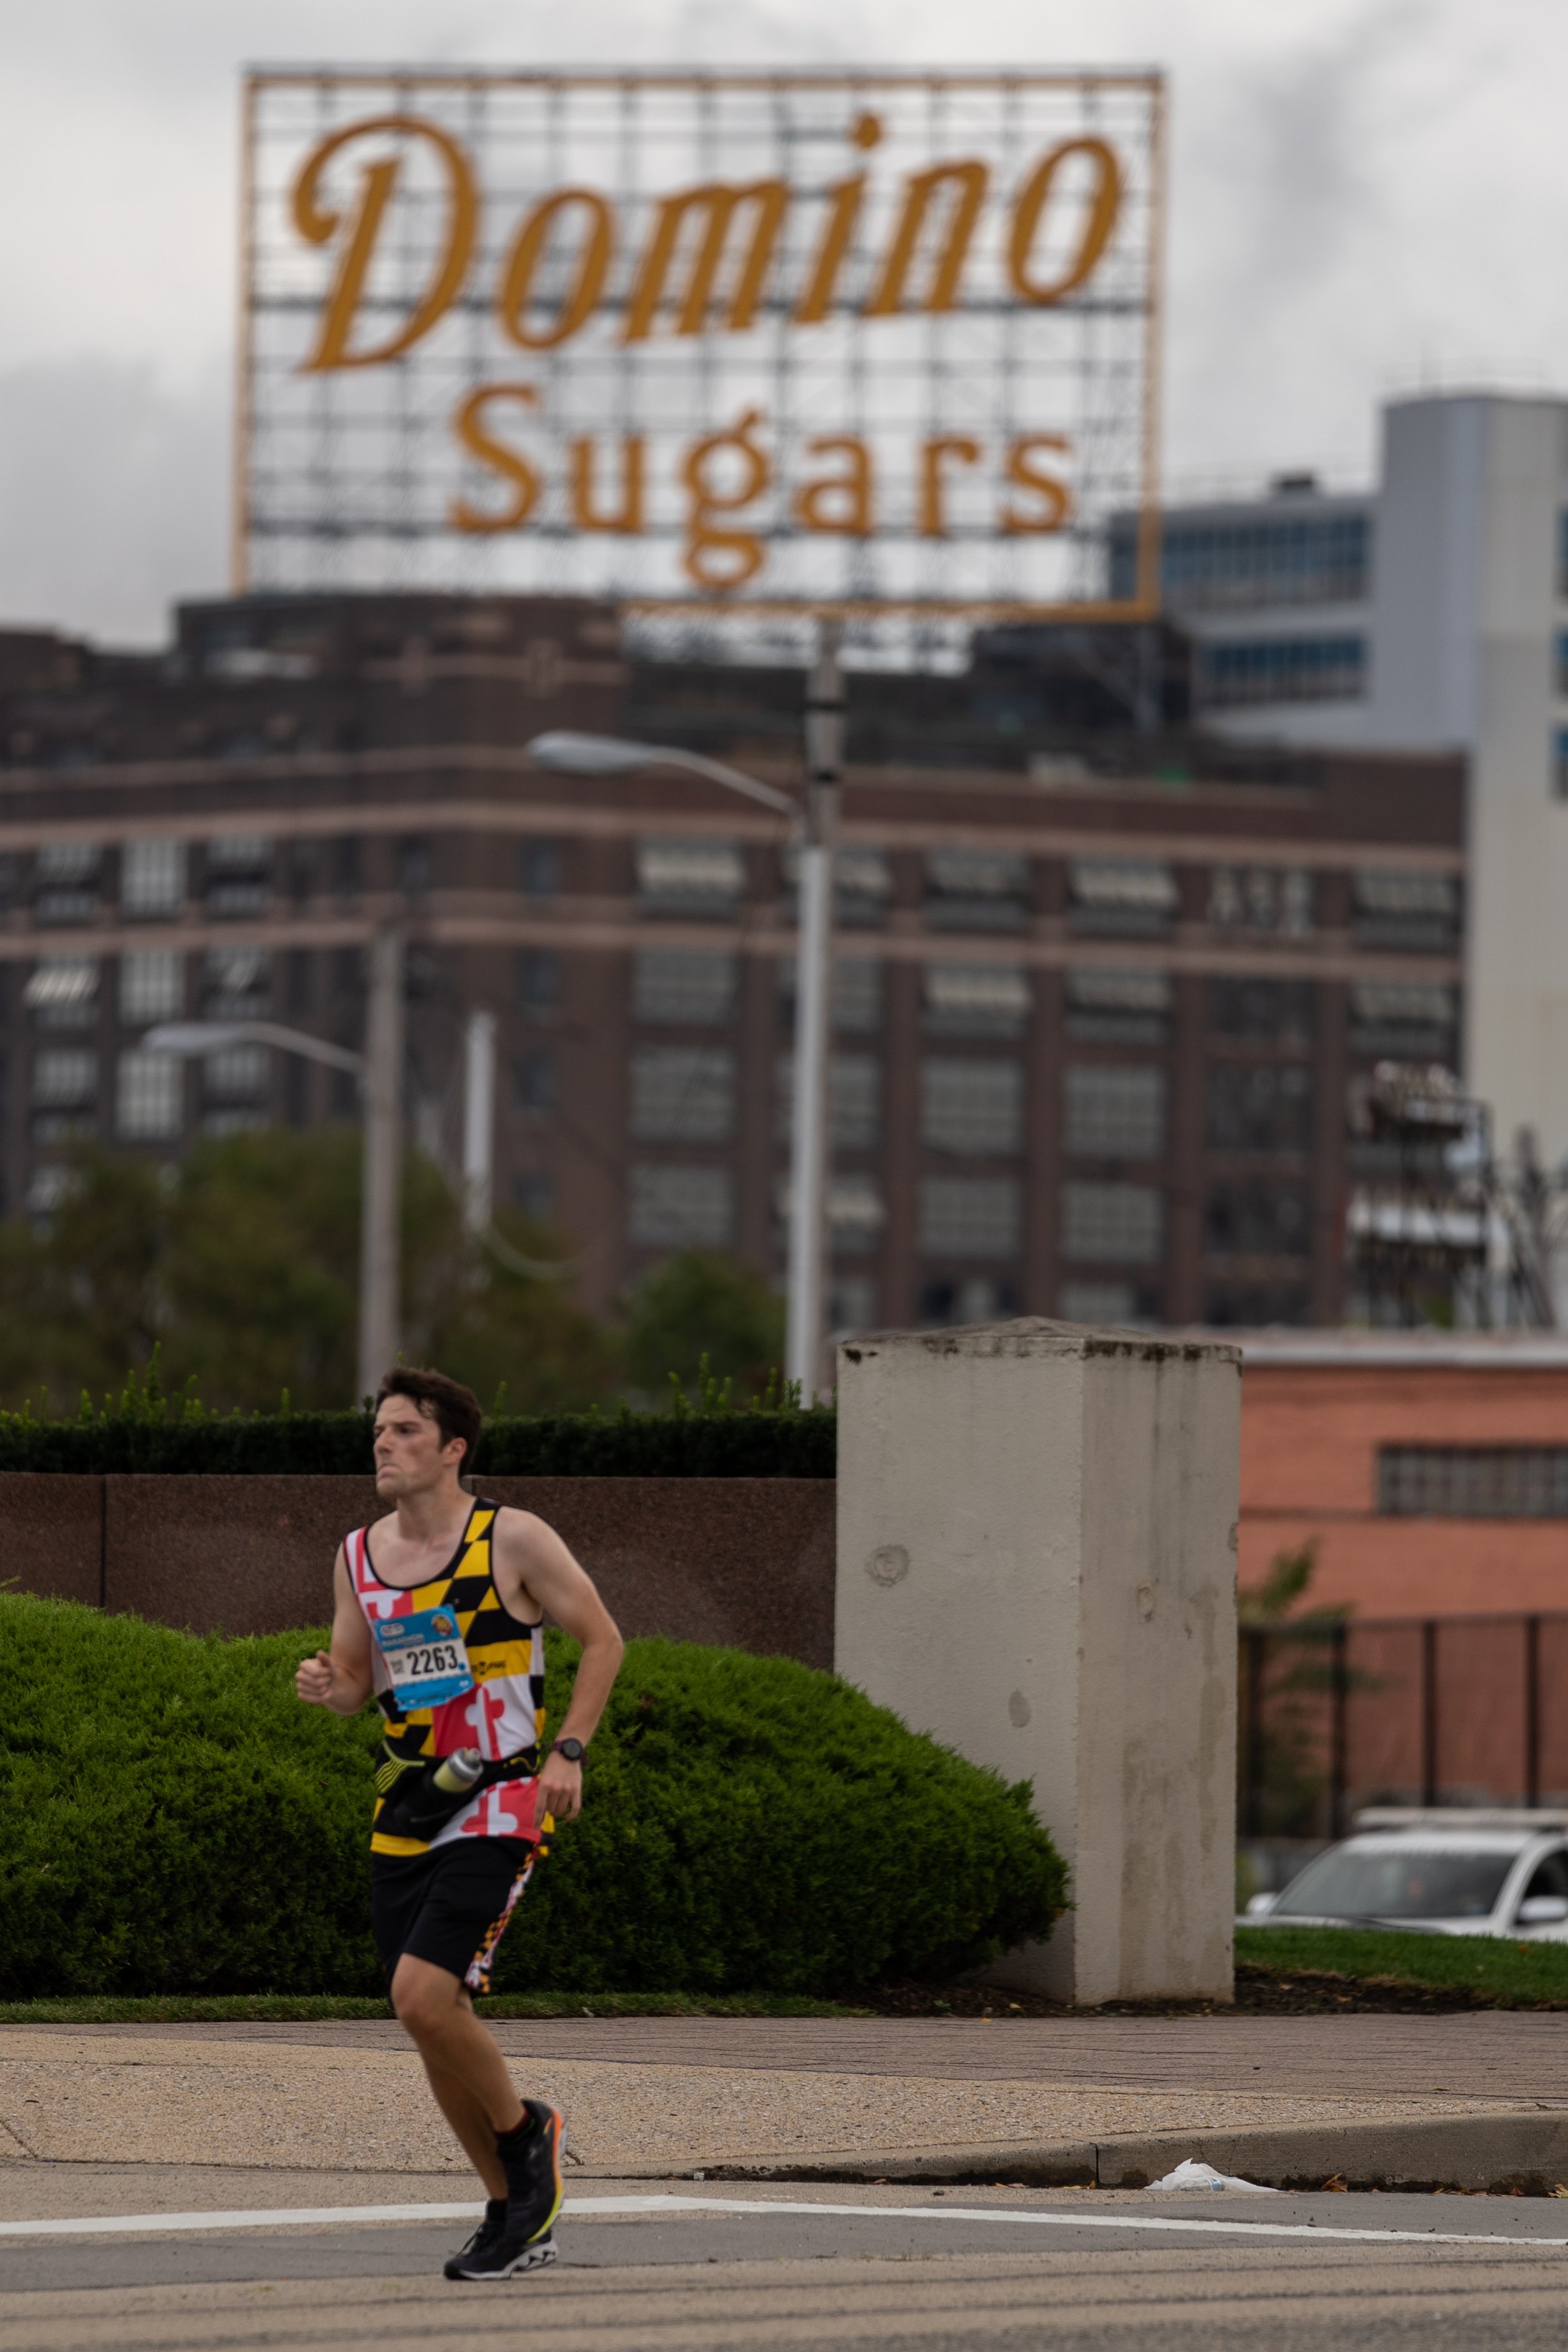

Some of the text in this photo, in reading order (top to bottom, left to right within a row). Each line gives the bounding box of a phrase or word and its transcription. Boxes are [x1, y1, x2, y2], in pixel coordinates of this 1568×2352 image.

[290, 111, 1124, 375] Domino
[446, 383, 1078, 591] Sugars
[406, 1645, 458, 1675] 2263
